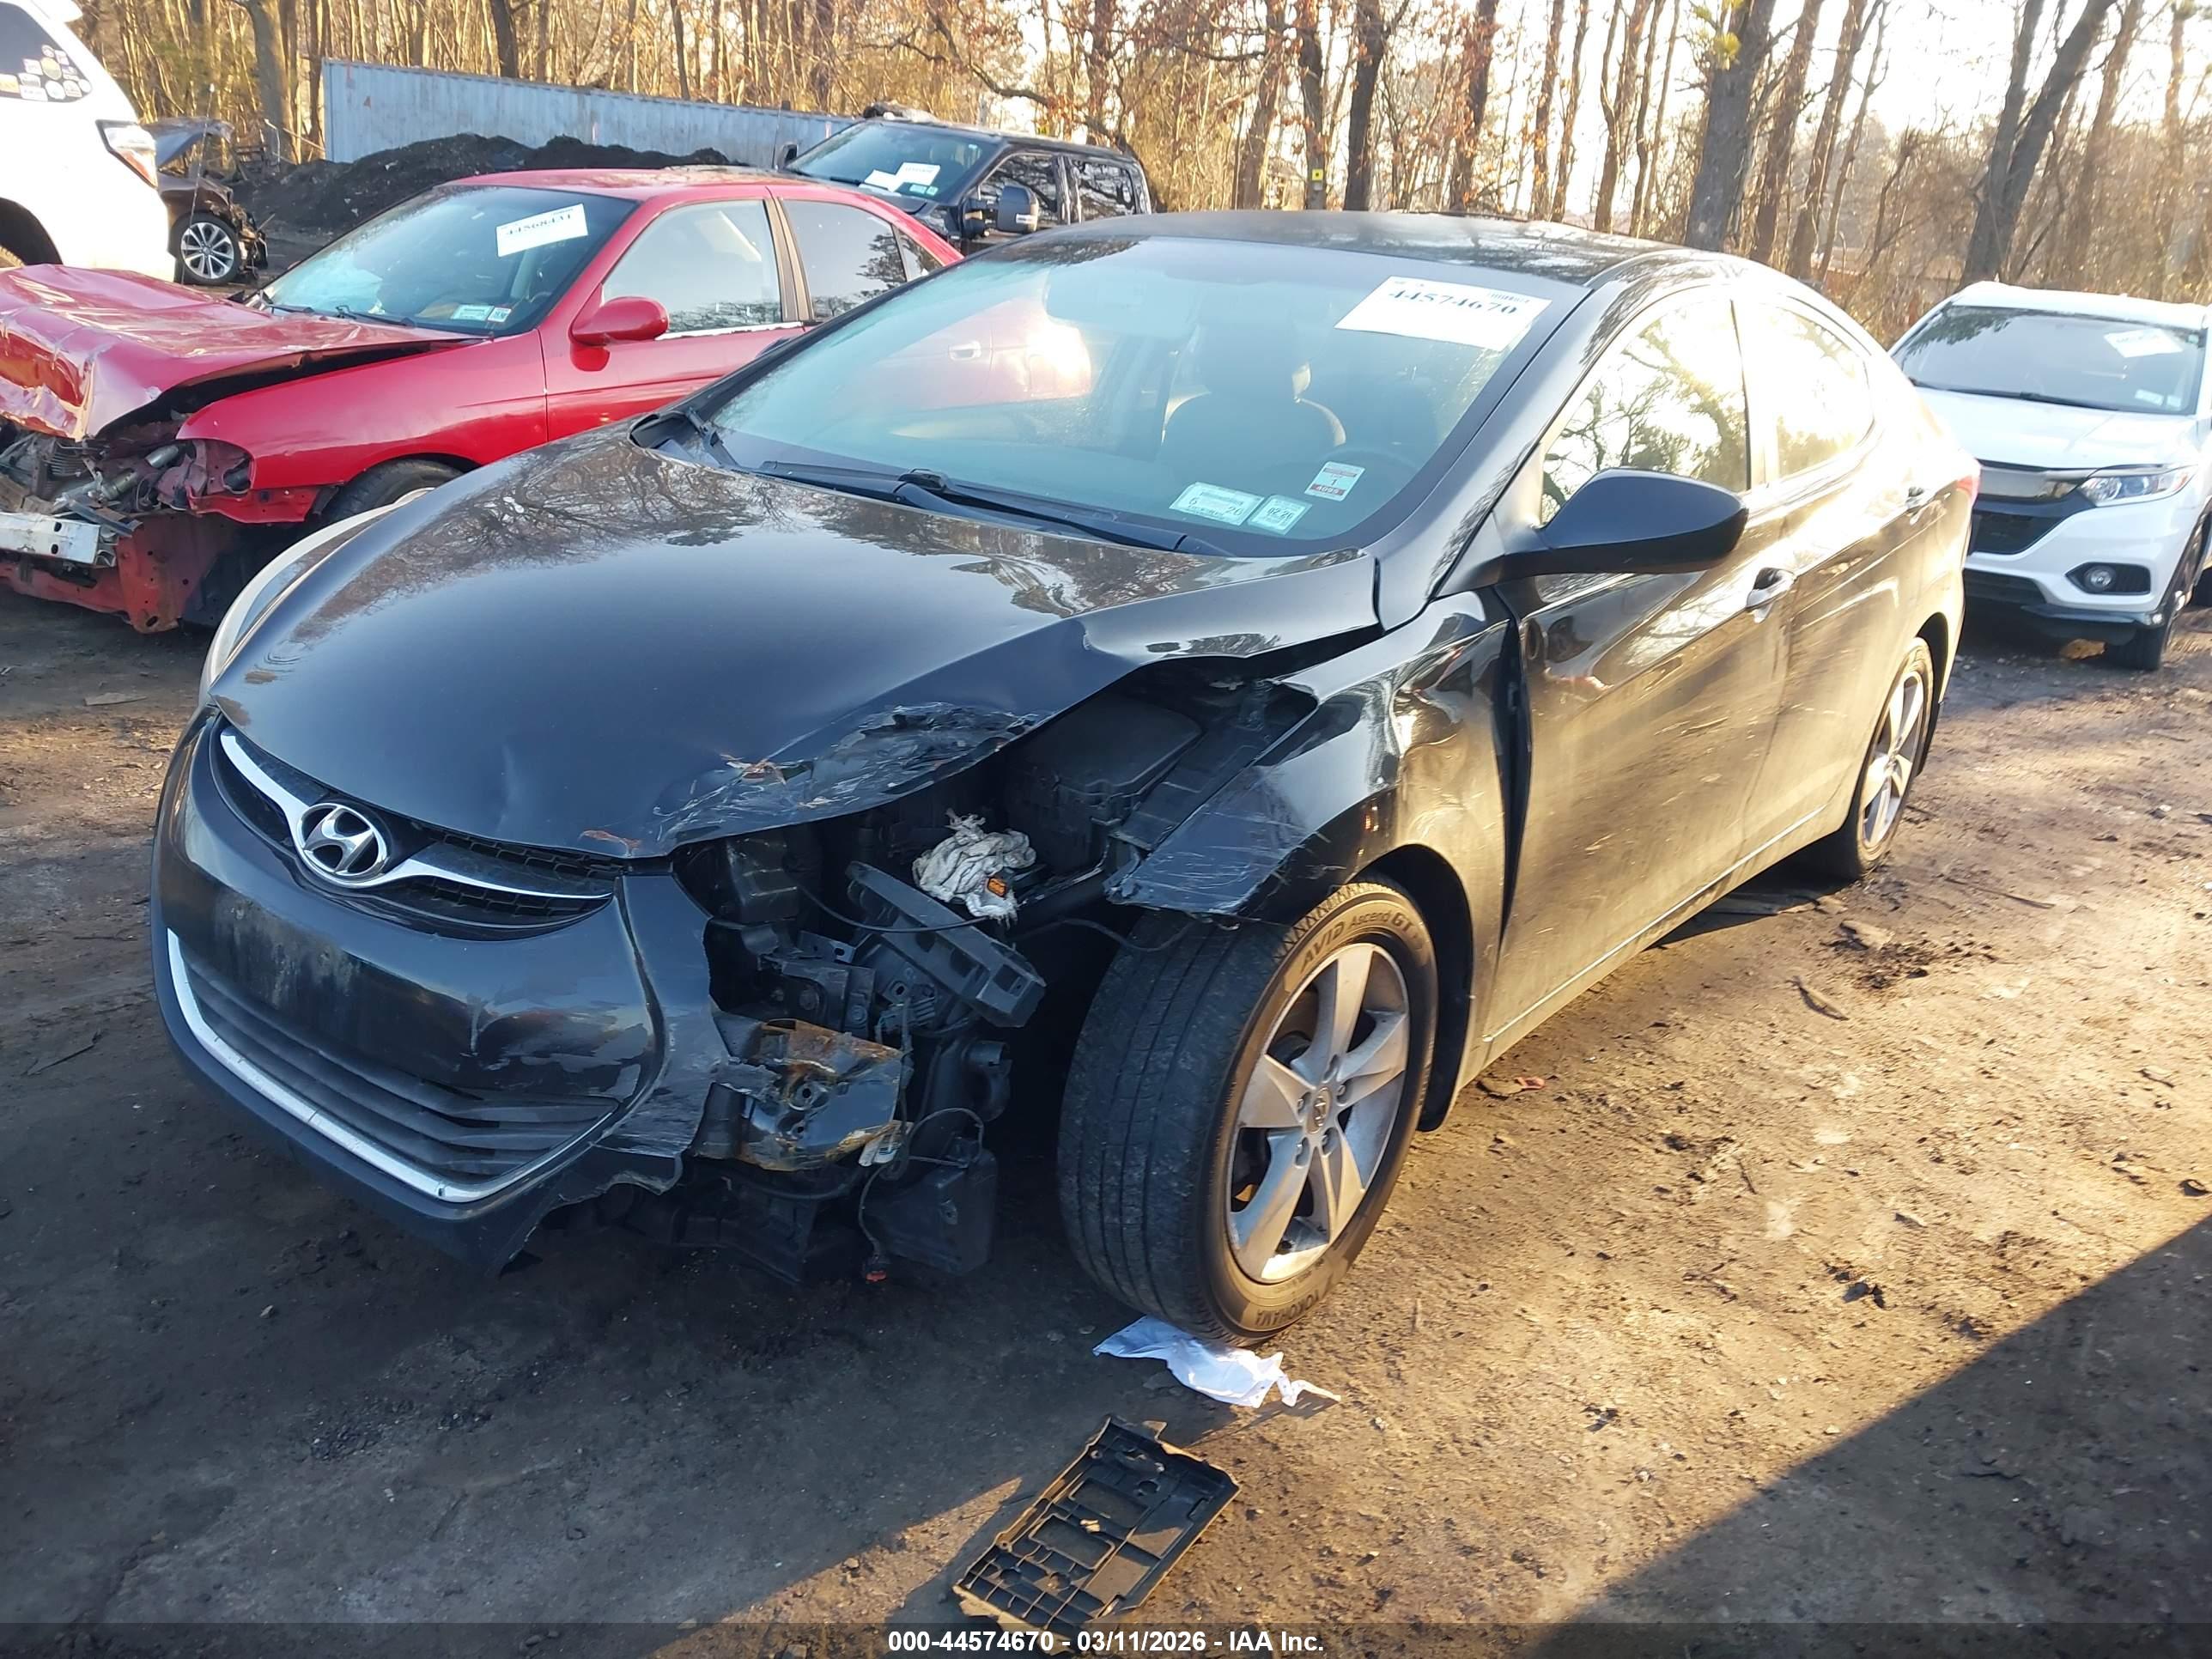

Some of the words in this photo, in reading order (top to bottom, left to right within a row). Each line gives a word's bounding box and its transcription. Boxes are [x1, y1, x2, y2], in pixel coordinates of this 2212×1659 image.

[1389, 289, 1517, 314] 44574670
[1300, 921, 1346, 974] AVID
[1347, 910, 1392, 930] Ascend
[1391, 912, 1415, 933] GT
